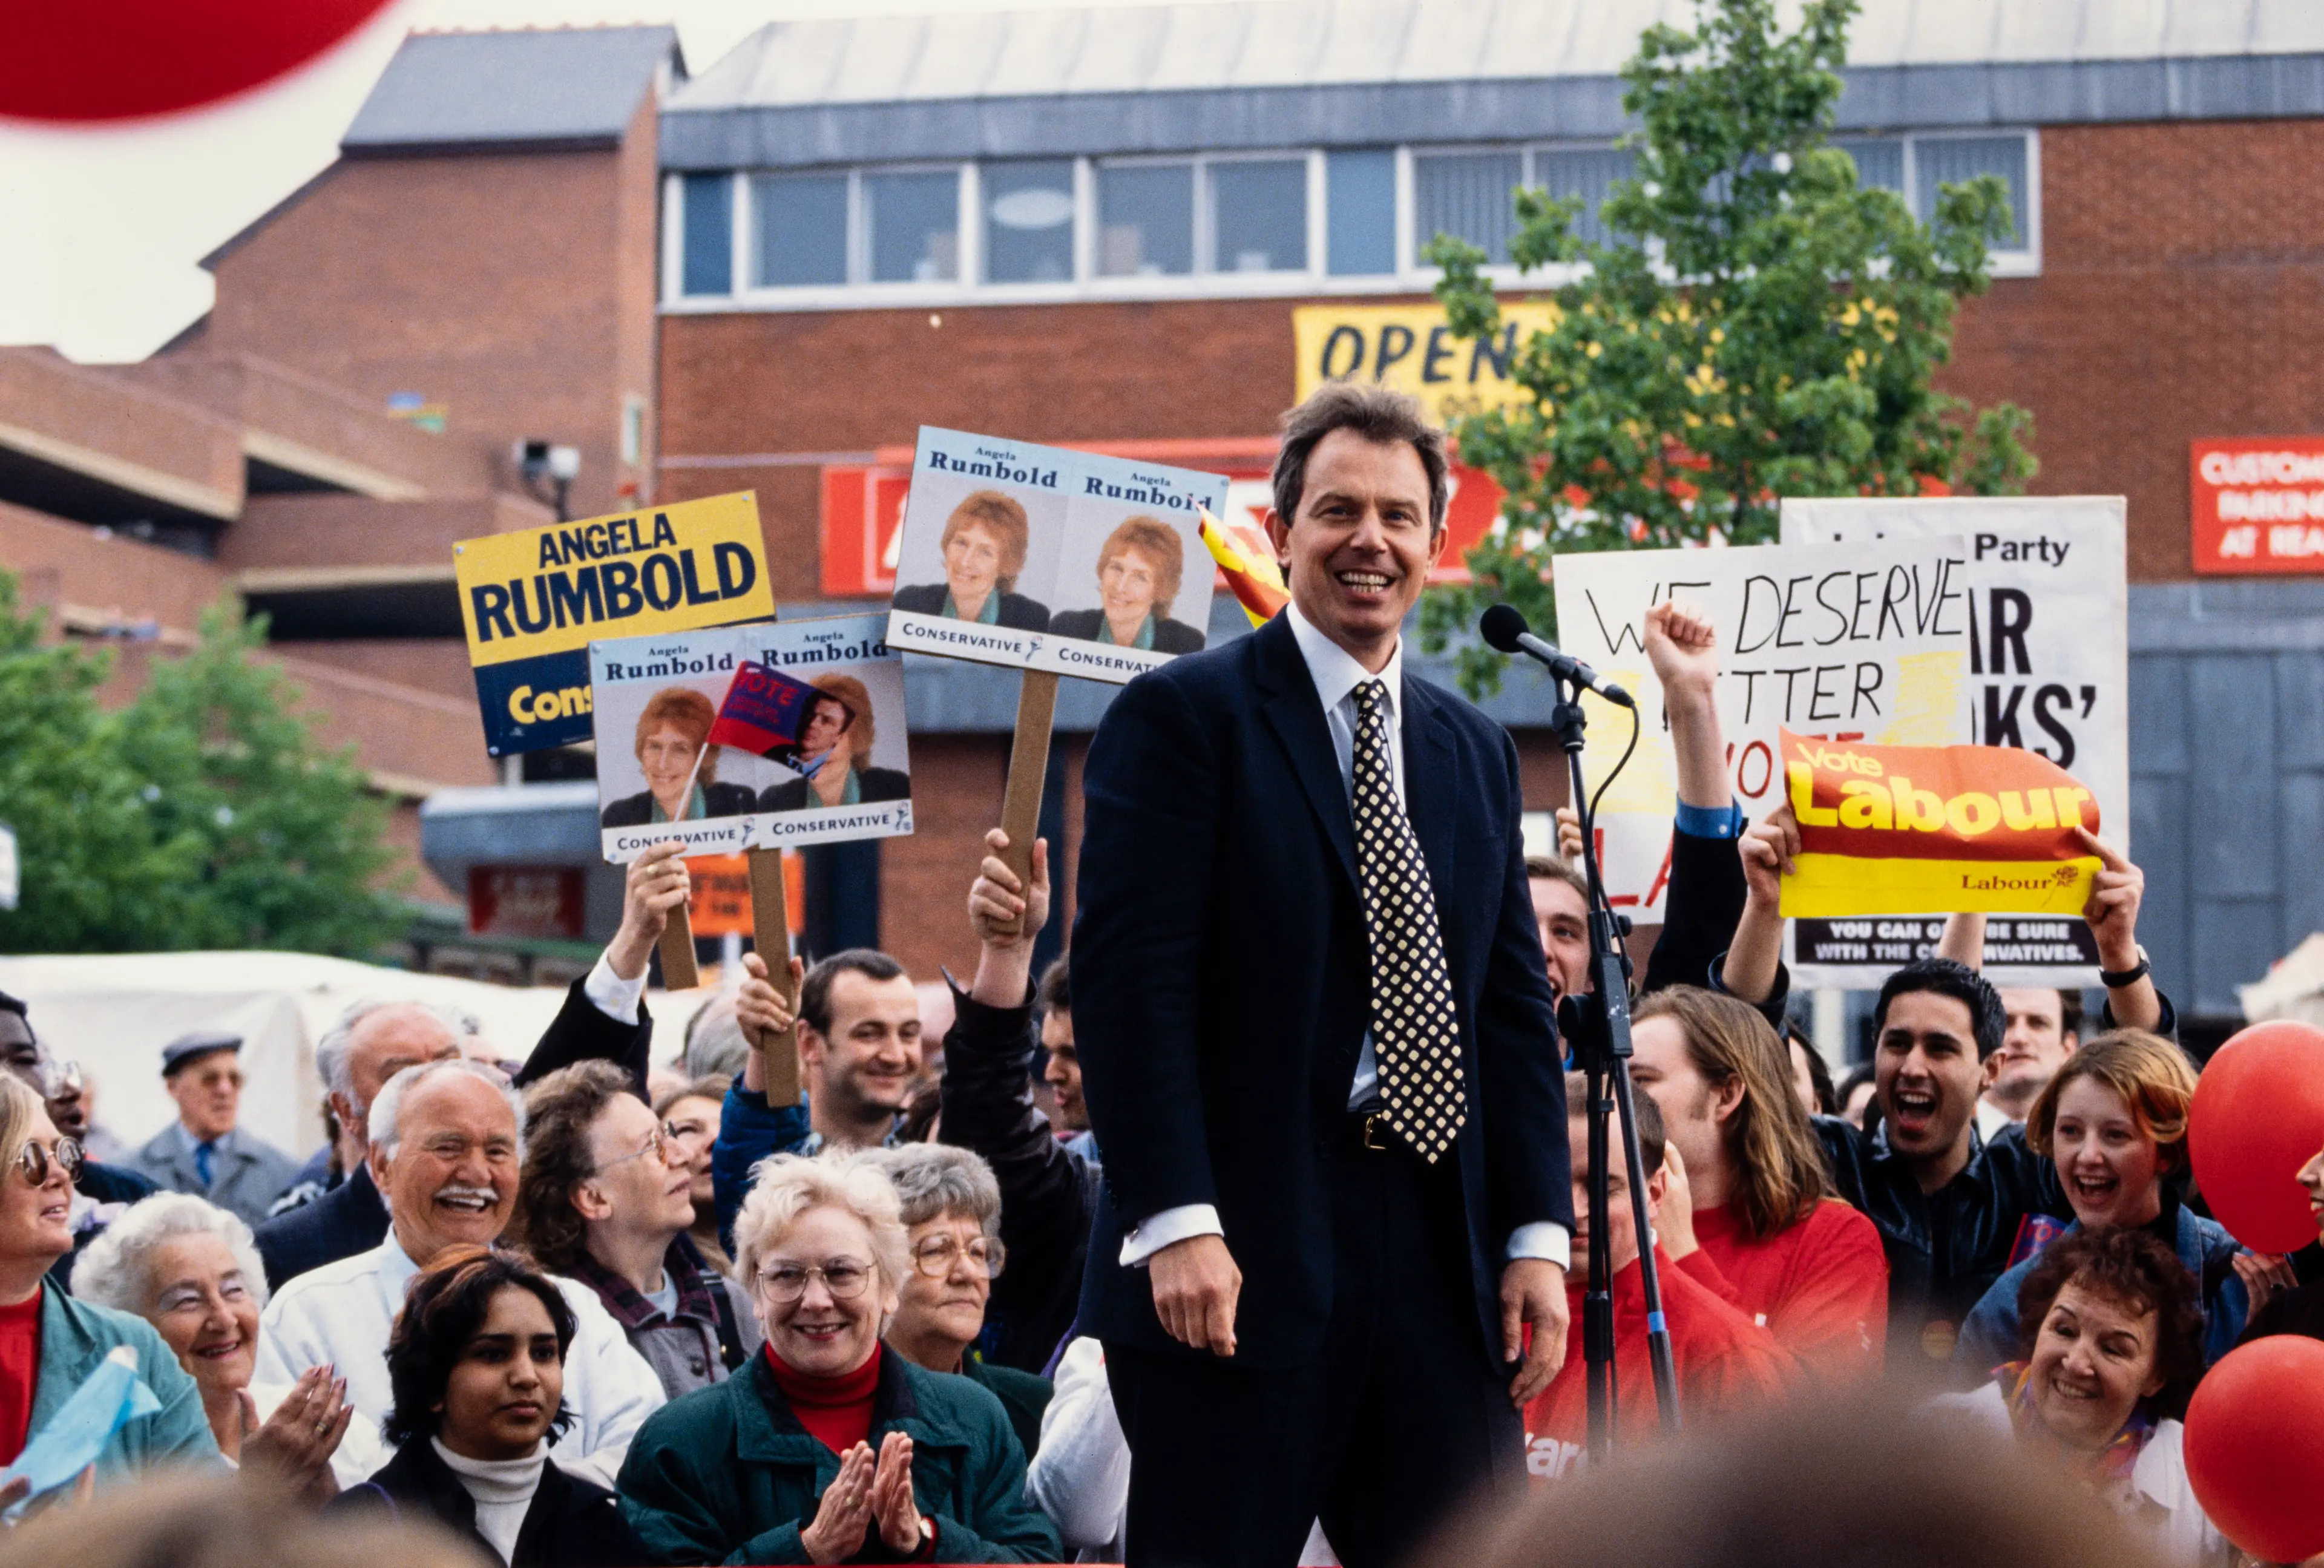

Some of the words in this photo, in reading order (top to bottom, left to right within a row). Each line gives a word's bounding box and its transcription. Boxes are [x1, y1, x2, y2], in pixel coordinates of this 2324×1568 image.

[1320, 321, 1518, 384] OPEN
[928, 450, 1057, 489] Rumbold
[974, 446, 1016, 461] Angela
[1085, 476, 1212, 511] Rumbold
[1130, 472, 1170, 487] Angela
[539, 514, 676, 568] ANGELA
[1975, 534, 2070, 567] Party
[2219, 525, 2259, 558] AT
[471, 542, 756, 643] RUMBOLD
[1735, 559, 1965, 654] DESERVE
[649, 646, 689, 657] Angela
[761, 640, 888, 667] Rumbold
[803, 632, 844, 643] Angela
[902, 622, 1021, 653] CONSERVATIVE
[606, 653, 734, 681] Rumbold
[738, 673, 799, 706] VOTE
[1796, 743, 1883, 777] Vote
[1788, 760, 2090, 835] Labour
[772, 814, 890, 835] CONSERVATIVE
[1961, 874, 2052, 891] Labour
[1830, 922, 1873, 939] YOU
[1877, 922, 1922, 939] CAN
[2017, 923, 2070, 940] SURE
[1815, 943, 1868, 960] WITH
[1871, 943, 1910, 960] THE
